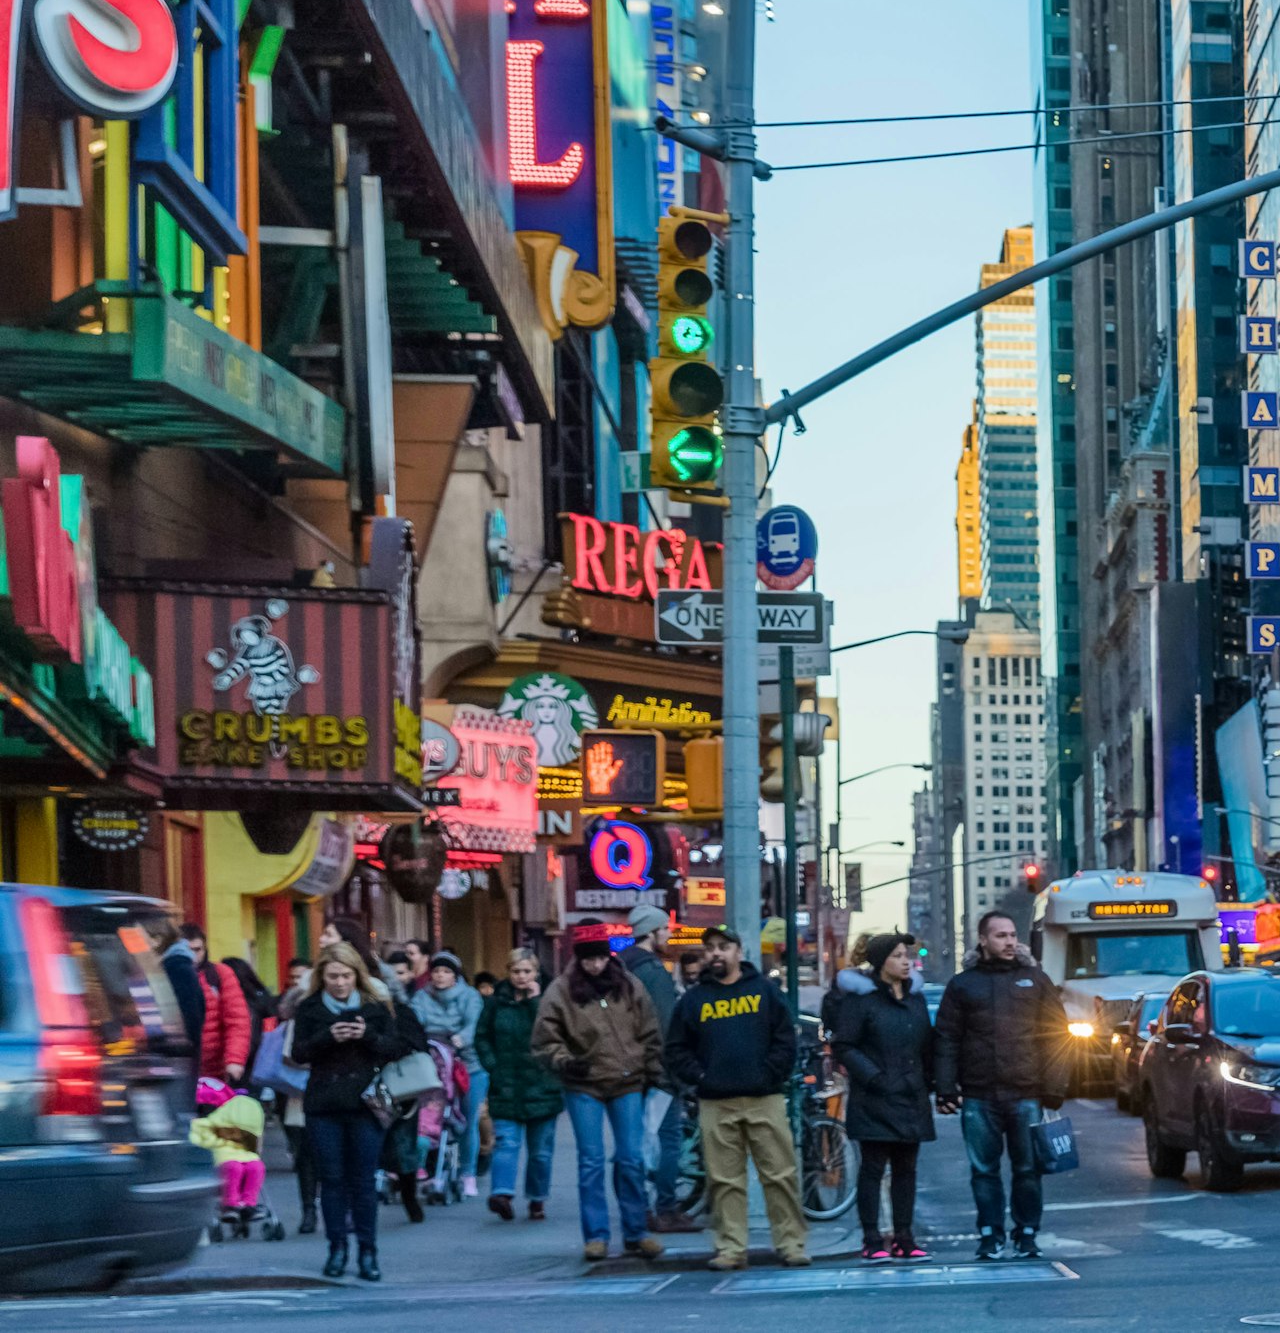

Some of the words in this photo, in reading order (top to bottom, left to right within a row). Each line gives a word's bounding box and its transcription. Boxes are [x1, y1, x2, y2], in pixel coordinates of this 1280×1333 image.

[1250, 246, 1279, 650] CHAMPS
[758, 608, 809, 628] WAY
[180, 710, 369, 747] CRUMBS
[183, 742, 263, 766] BAKE
[289, 746, 368, 770] SHOP
[590, 819, 655, 891] Q
[1094, 903, 1170, 915] MANHATTAN
[700, 994, 762, 1023] ARMY
